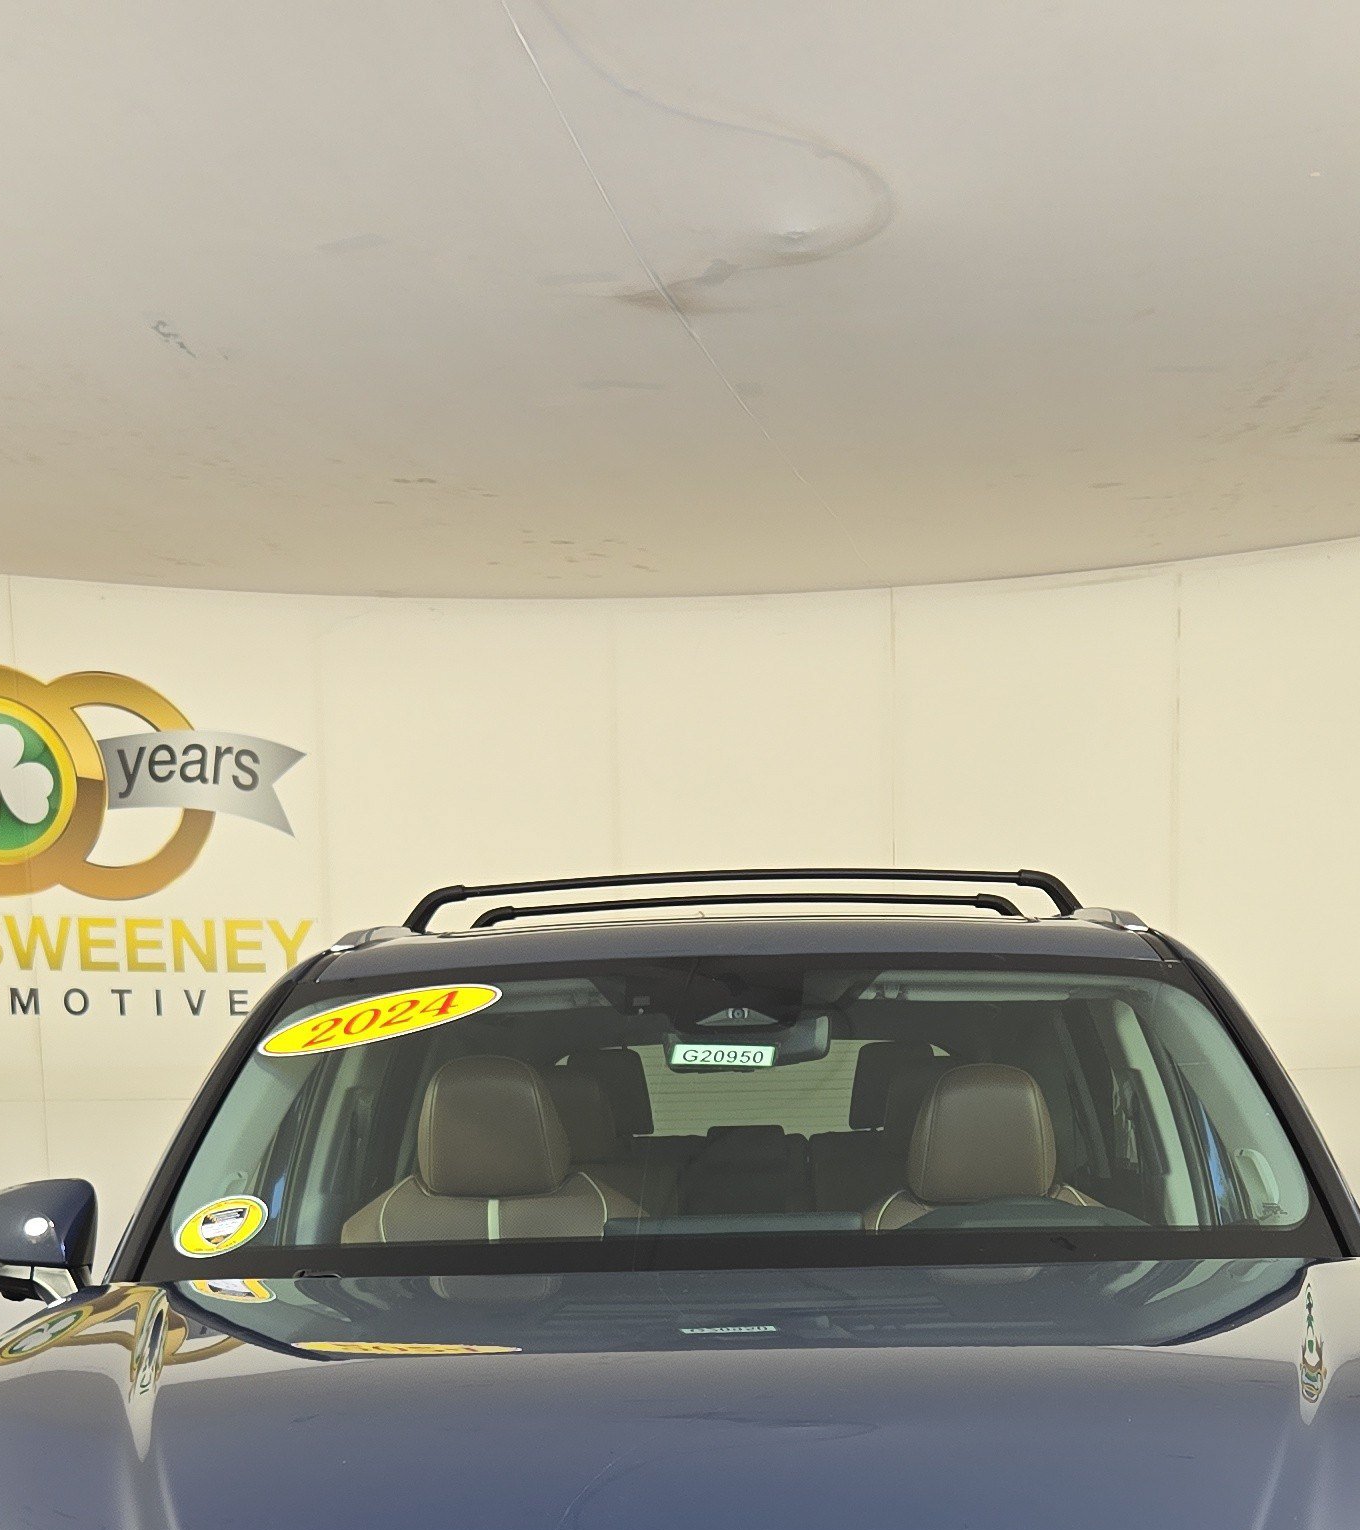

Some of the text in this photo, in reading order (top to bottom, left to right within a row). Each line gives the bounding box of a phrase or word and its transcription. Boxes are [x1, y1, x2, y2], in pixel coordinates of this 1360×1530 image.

[116, 742, 261, 798] years
[302, 991, 459, 1048] 2024
[683, 1049, 764, 1064] G20950
